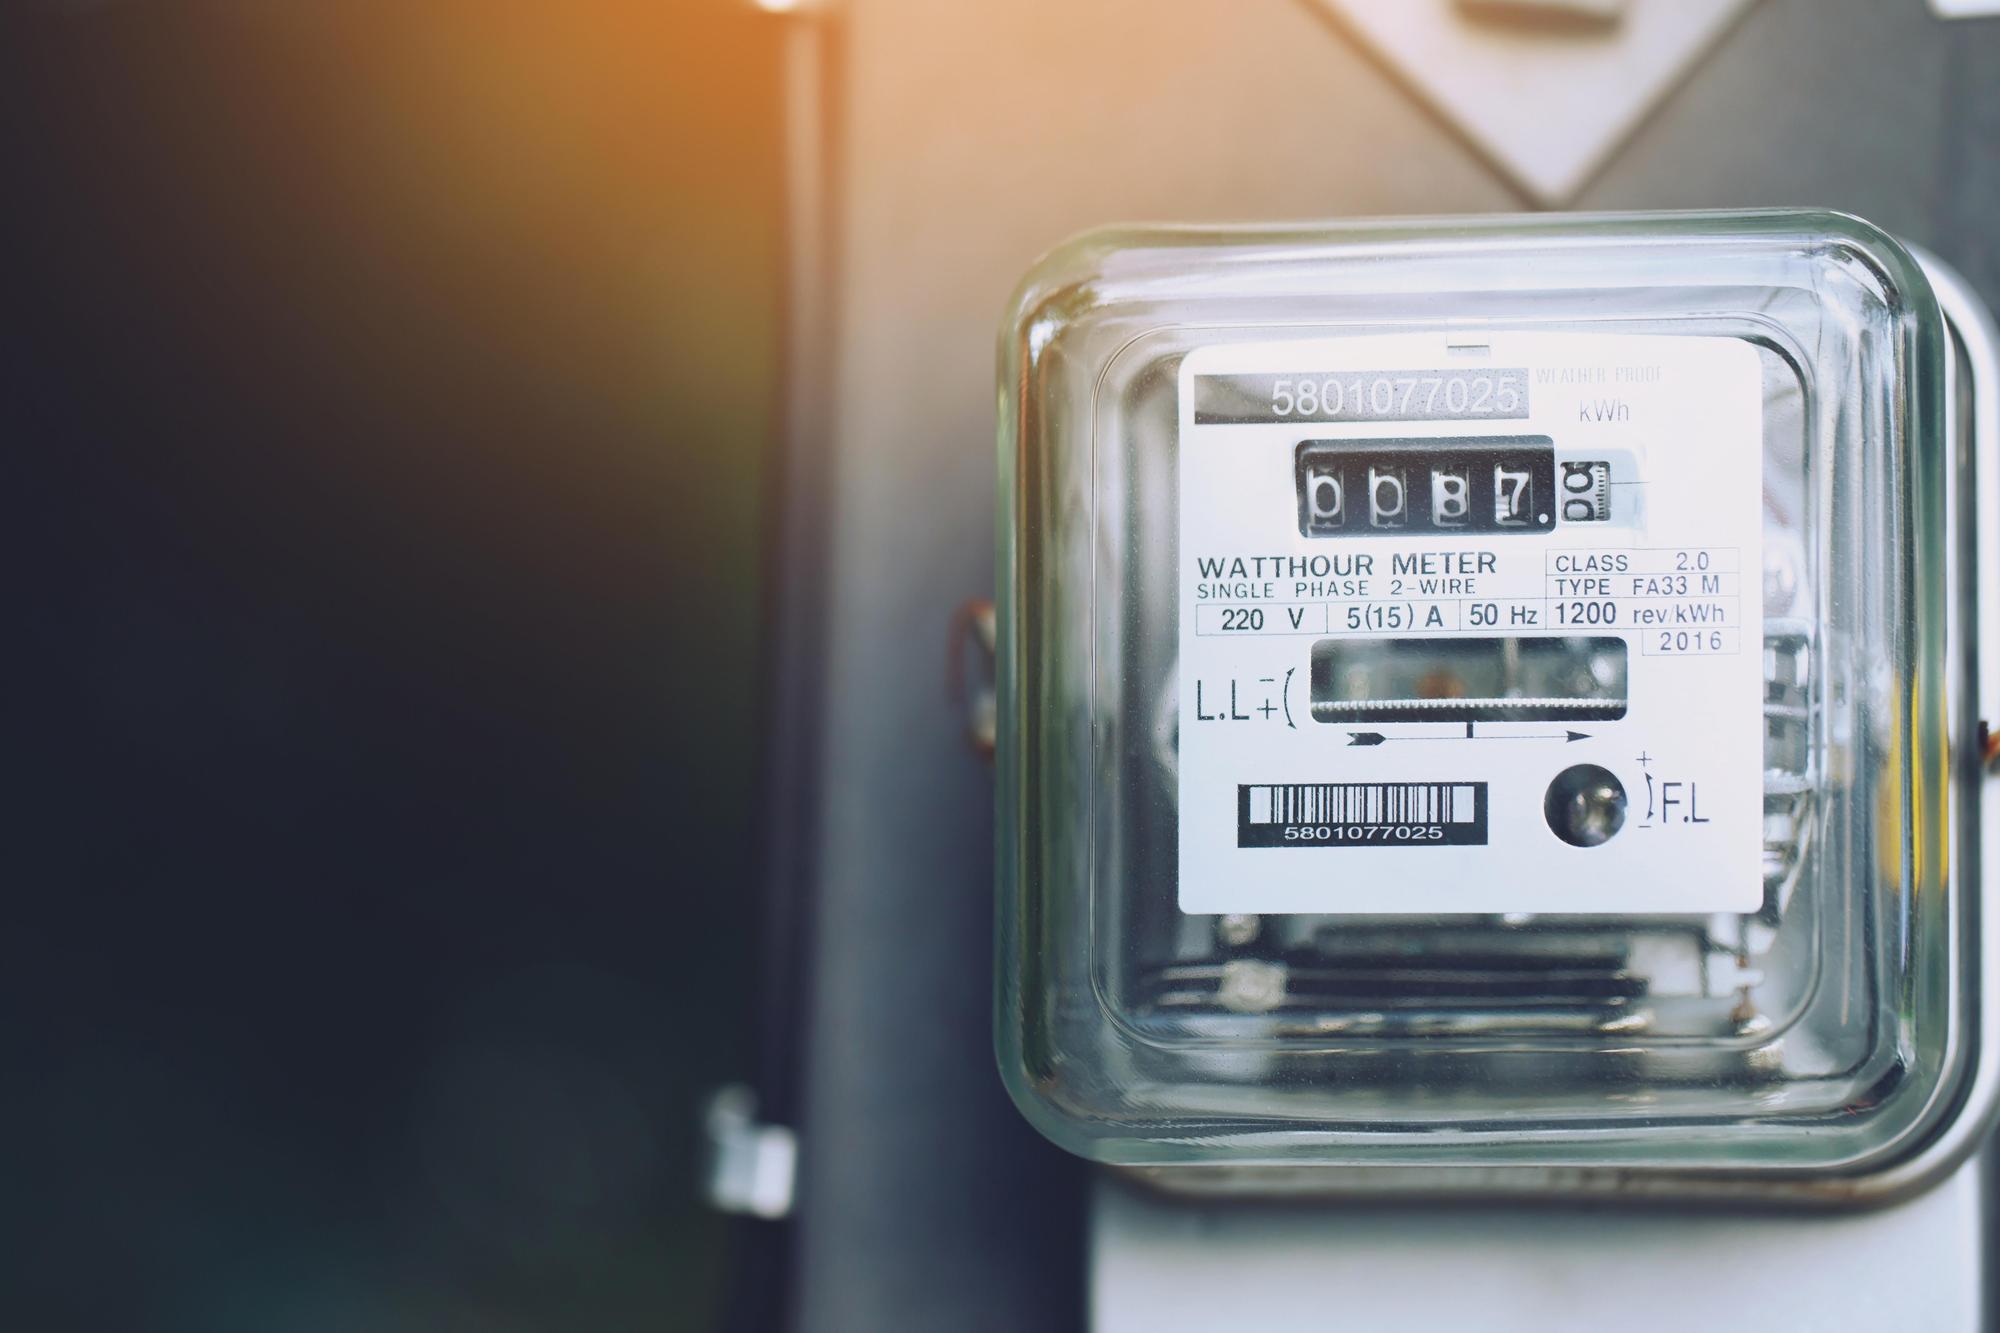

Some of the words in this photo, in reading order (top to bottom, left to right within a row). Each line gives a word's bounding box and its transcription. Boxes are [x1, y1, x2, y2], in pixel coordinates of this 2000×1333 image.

[1536, 366, 1606, 385] WEATHER
[1614, 363, 1662, 383] PROOF
[1271, 377, 1519, 416] 5801077025
[1579, 398, 1629, 422] kWh
[1197, 554, 1374, 579] WATTHOUR
[1392, 551, 1497, 576] METER
[1555, 555, 1629, 572] CLASS
[1675, 551, 1710, 571] 2.0
[1196, 582, 1275, 599] SINGLE
[1295, 580, 1369, 597] PHASE
[1390, 578, 1476, 595] 2-WIRE
[1555, 578, 1611, 595] TYPE
[1632, 576, 1688, 595] FA33
[1702, 574, 1720, 594] M
[1221, 608, 1265, 631] 220
[1288, 607, 1305, 630] V
[1346, 603, 1414, 630] 5(15)
[1424, 605, 1444, 628] A
[1469, 603, 1498, 626] 50
[1510, 605, 1538, 625] Hz
[1555, 601, 1617, 625] 1200
[1632, 603, 1725, 624] rev/kWh
[1659, 631, 1722, 651] 2016
[1197, 679, 1250, 720] L.L
[1662, 781, 1710, 823] F.L
[1284, 825, 1443, 840] 5801077025
